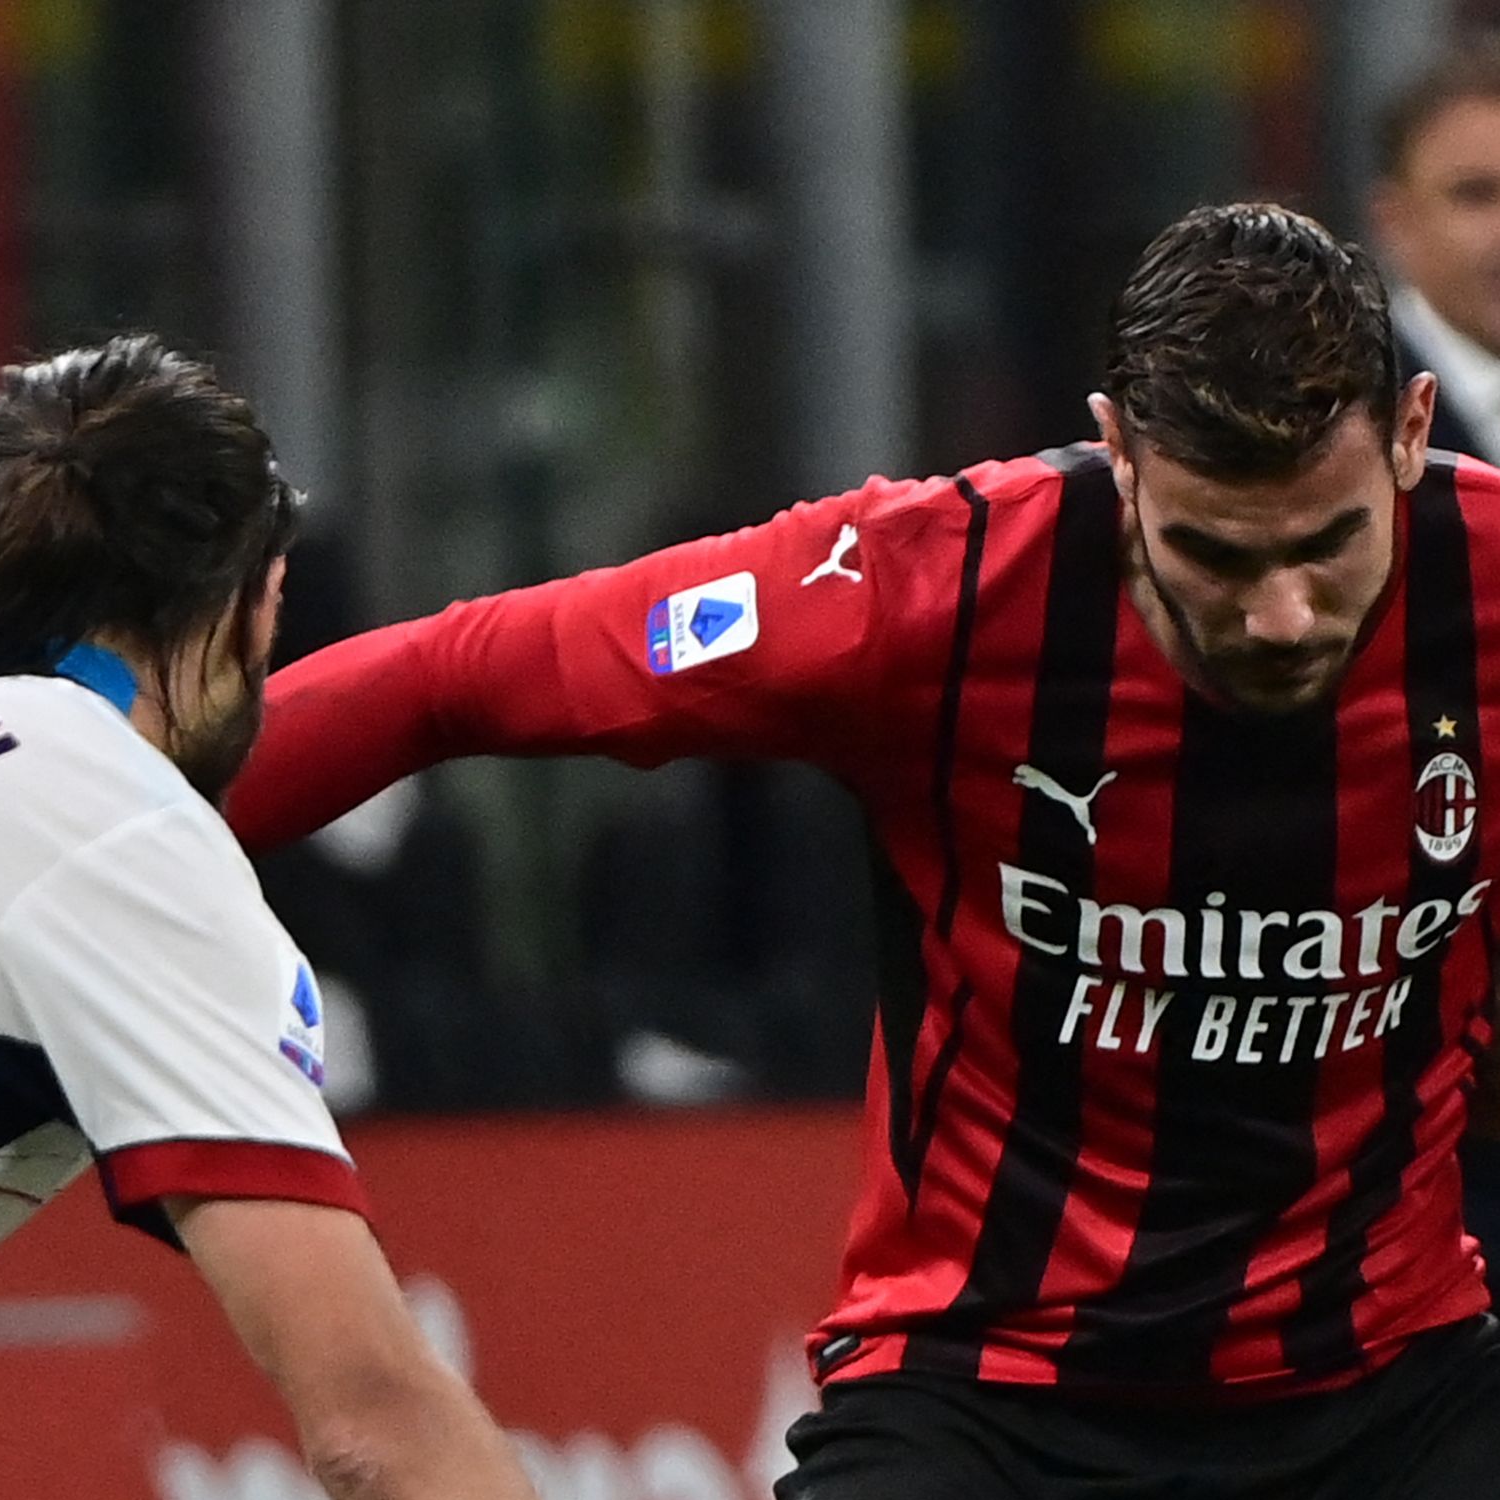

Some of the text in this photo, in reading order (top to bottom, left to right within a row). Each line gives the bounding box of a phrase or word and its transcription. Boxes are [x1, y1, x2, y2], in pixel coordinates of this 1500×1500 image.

[1426, 756, 1467, 778] ACM
[1428, 839, 1461, 851] 1899
[998, 861, 1492, 980] Emirates
[1058, 974, 1414, 1065] FLY BETTER
